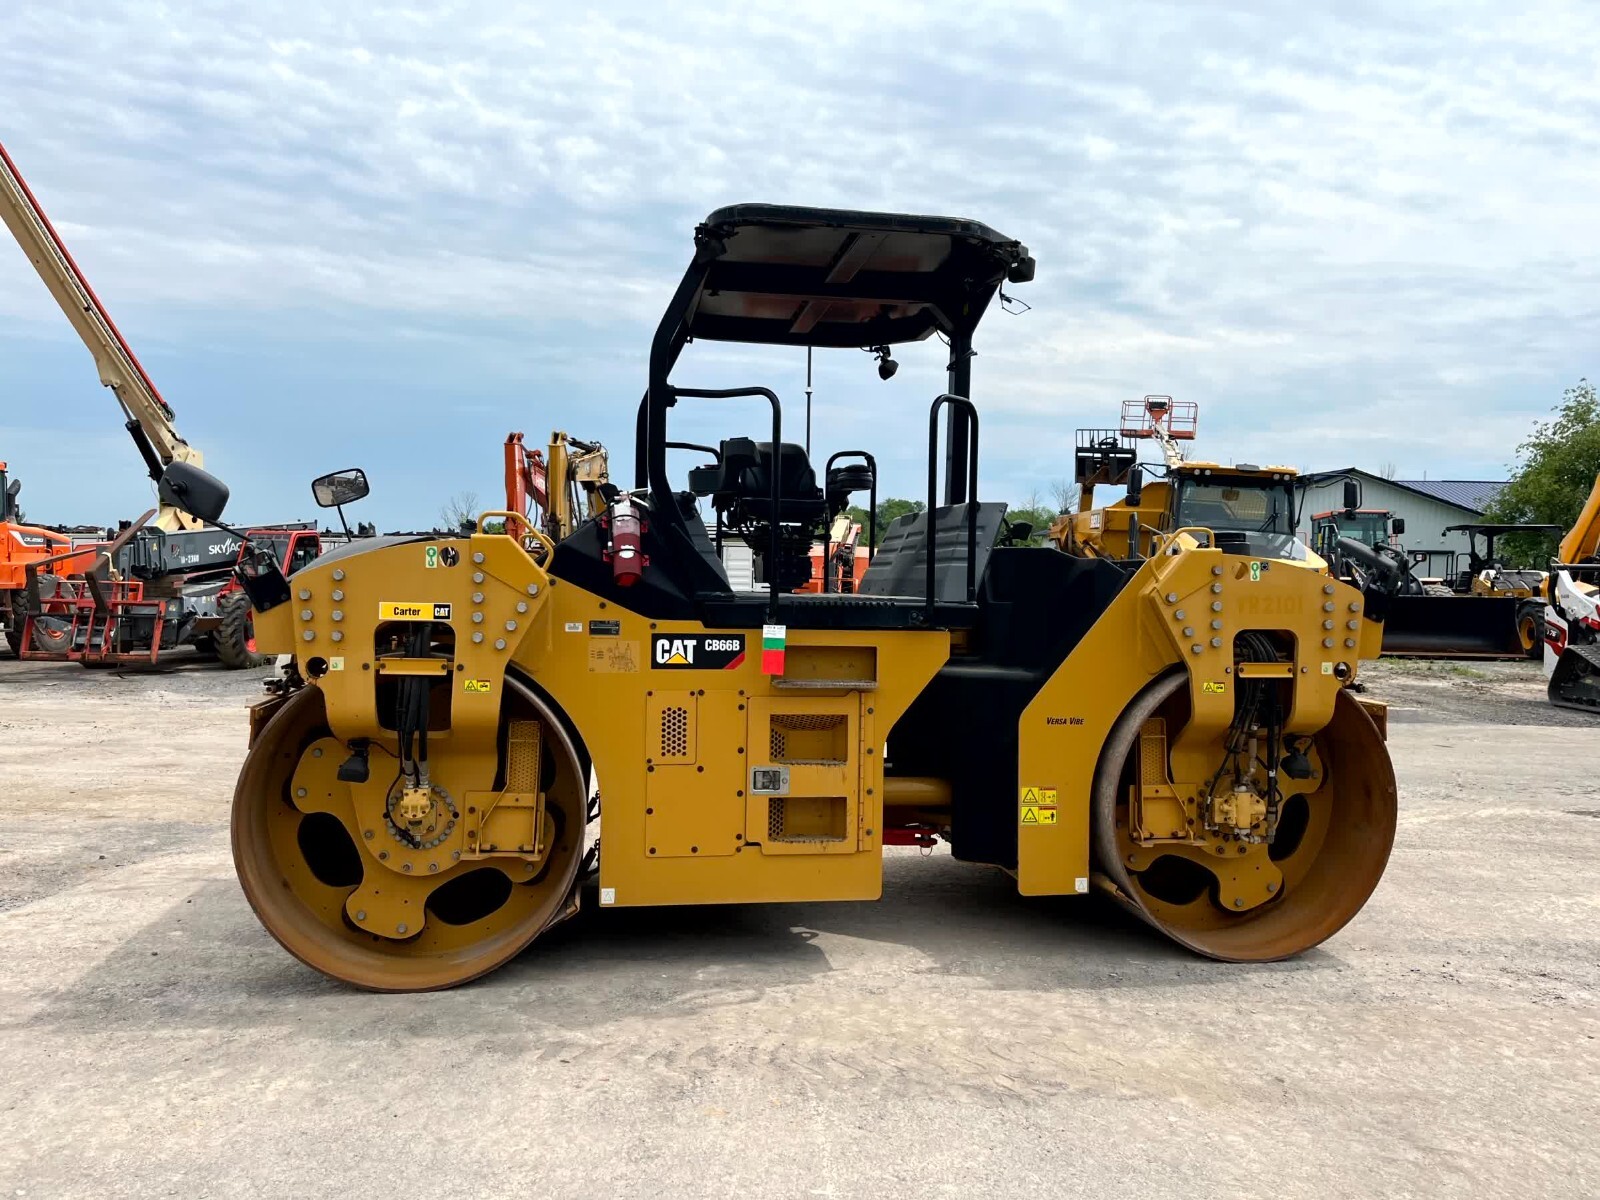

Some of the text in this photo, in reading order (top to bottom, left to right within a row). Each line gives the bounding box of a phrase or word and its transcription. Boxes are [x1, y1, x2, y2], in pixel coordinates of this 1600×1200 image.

[208, 538, 243, 555] SKYJAC
[393, 606, 449, 616] Carter CAT
[656, 638, 741, 665] CAT CB66B
[1046, 717, 1085, 725] VERSA VIBE
